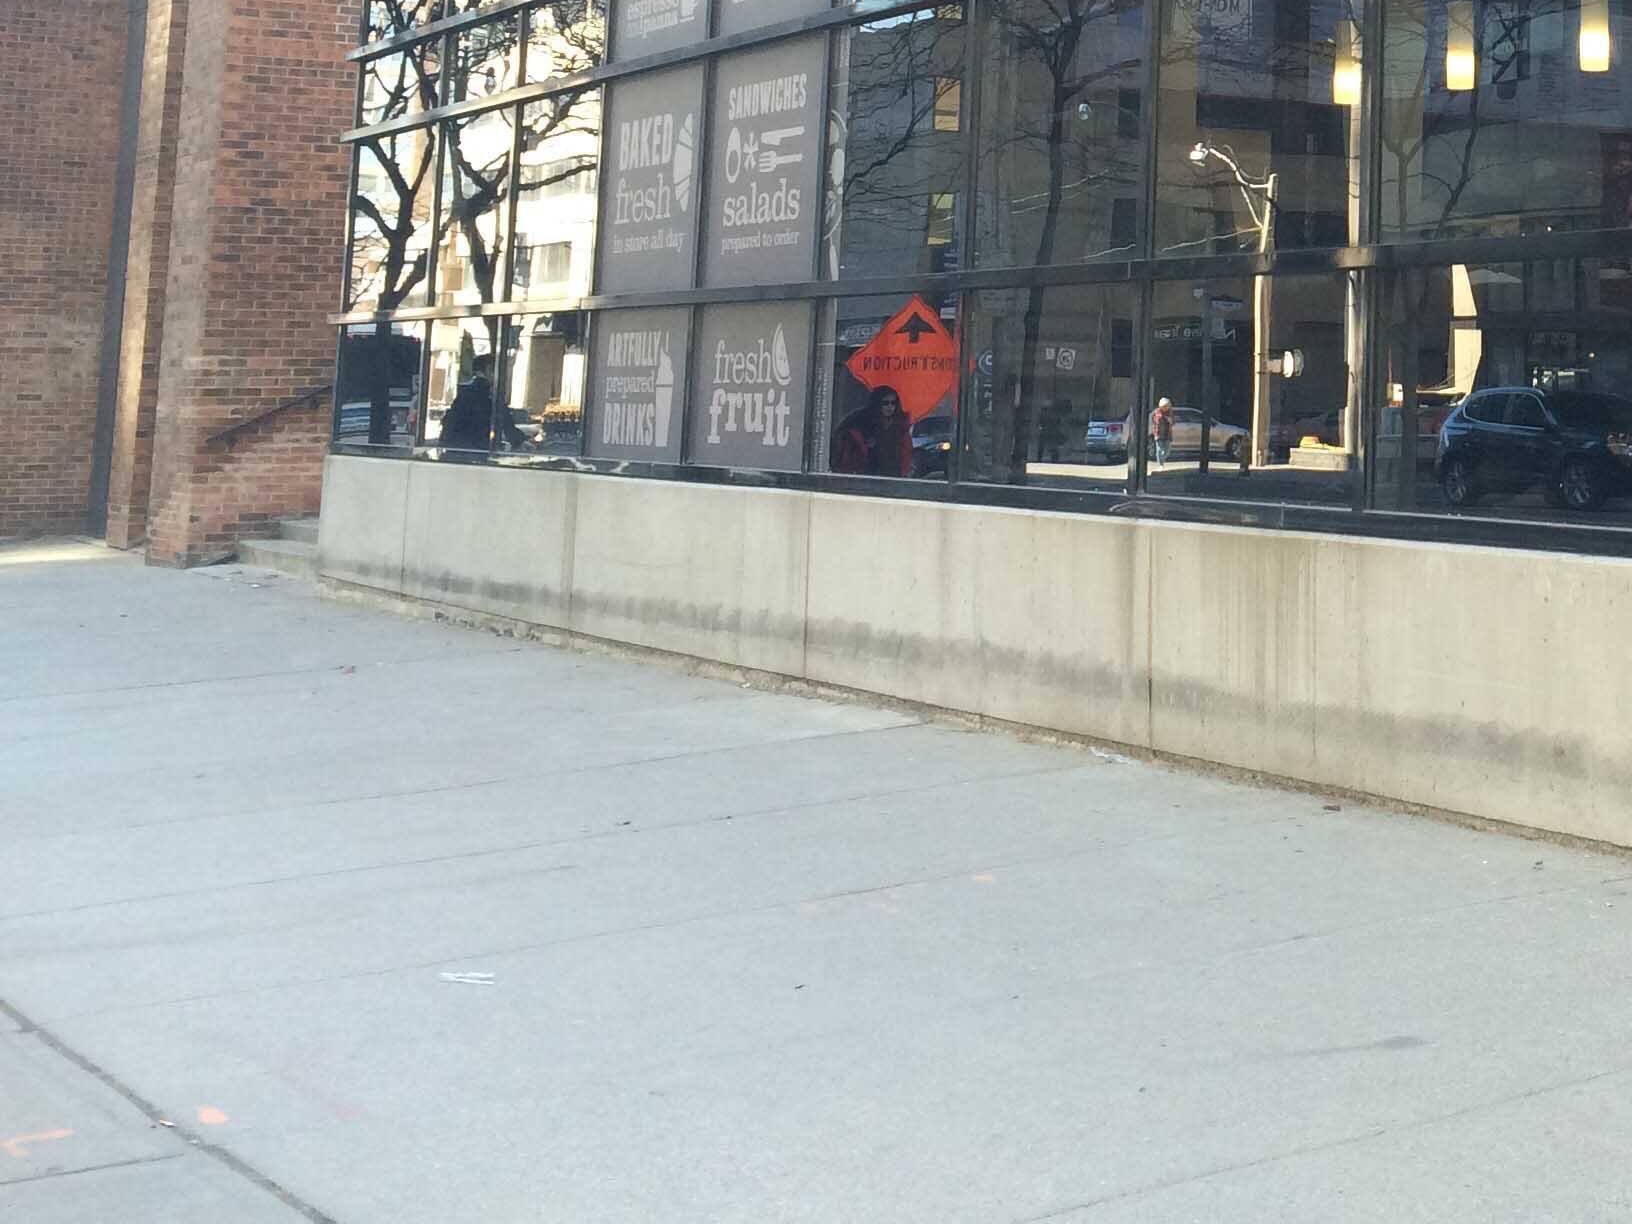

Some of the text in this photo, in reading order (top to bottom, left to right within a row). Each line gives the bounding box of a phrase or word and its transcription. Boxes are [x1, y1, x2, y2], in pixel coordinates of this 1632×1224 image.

[729, 74, 808, 121] SANDWICHES
[619, 113, 674, 171] BAKED
[614, 173, 672, 225] fresh
[723, 178, 801, 227] salads
[651, 229, 663, 249] all
[665, 230, 687, 253] day
[608, 331, 661, 366] ARTFULLY
[713, 339, 772, 385] fresh
[603, 402, 655, 446] DRINKS
[707, 388, 791, 447] fruit
